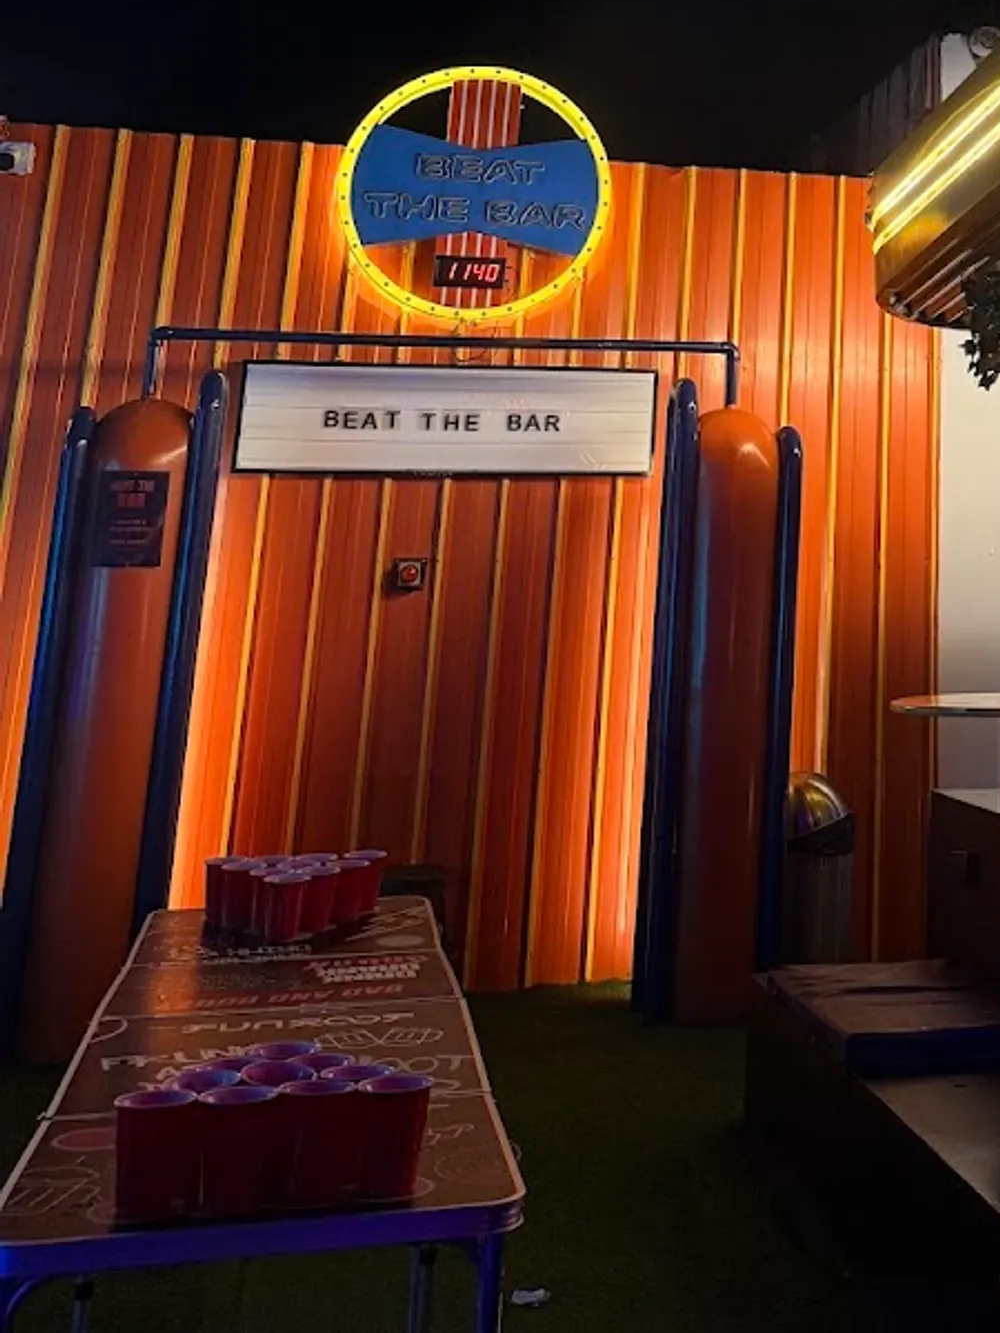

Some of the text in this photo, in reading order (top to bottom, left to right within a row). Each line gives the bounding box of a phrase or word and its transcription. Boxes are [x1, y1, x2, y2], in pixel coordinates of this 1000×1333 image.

[415, 152, 546, 185] BEAT
[364, 191, 586, 230] THE BAR
[448, 262, 500, 282] 1140
[323, 410, 561, 433] BEAT THE BAR
